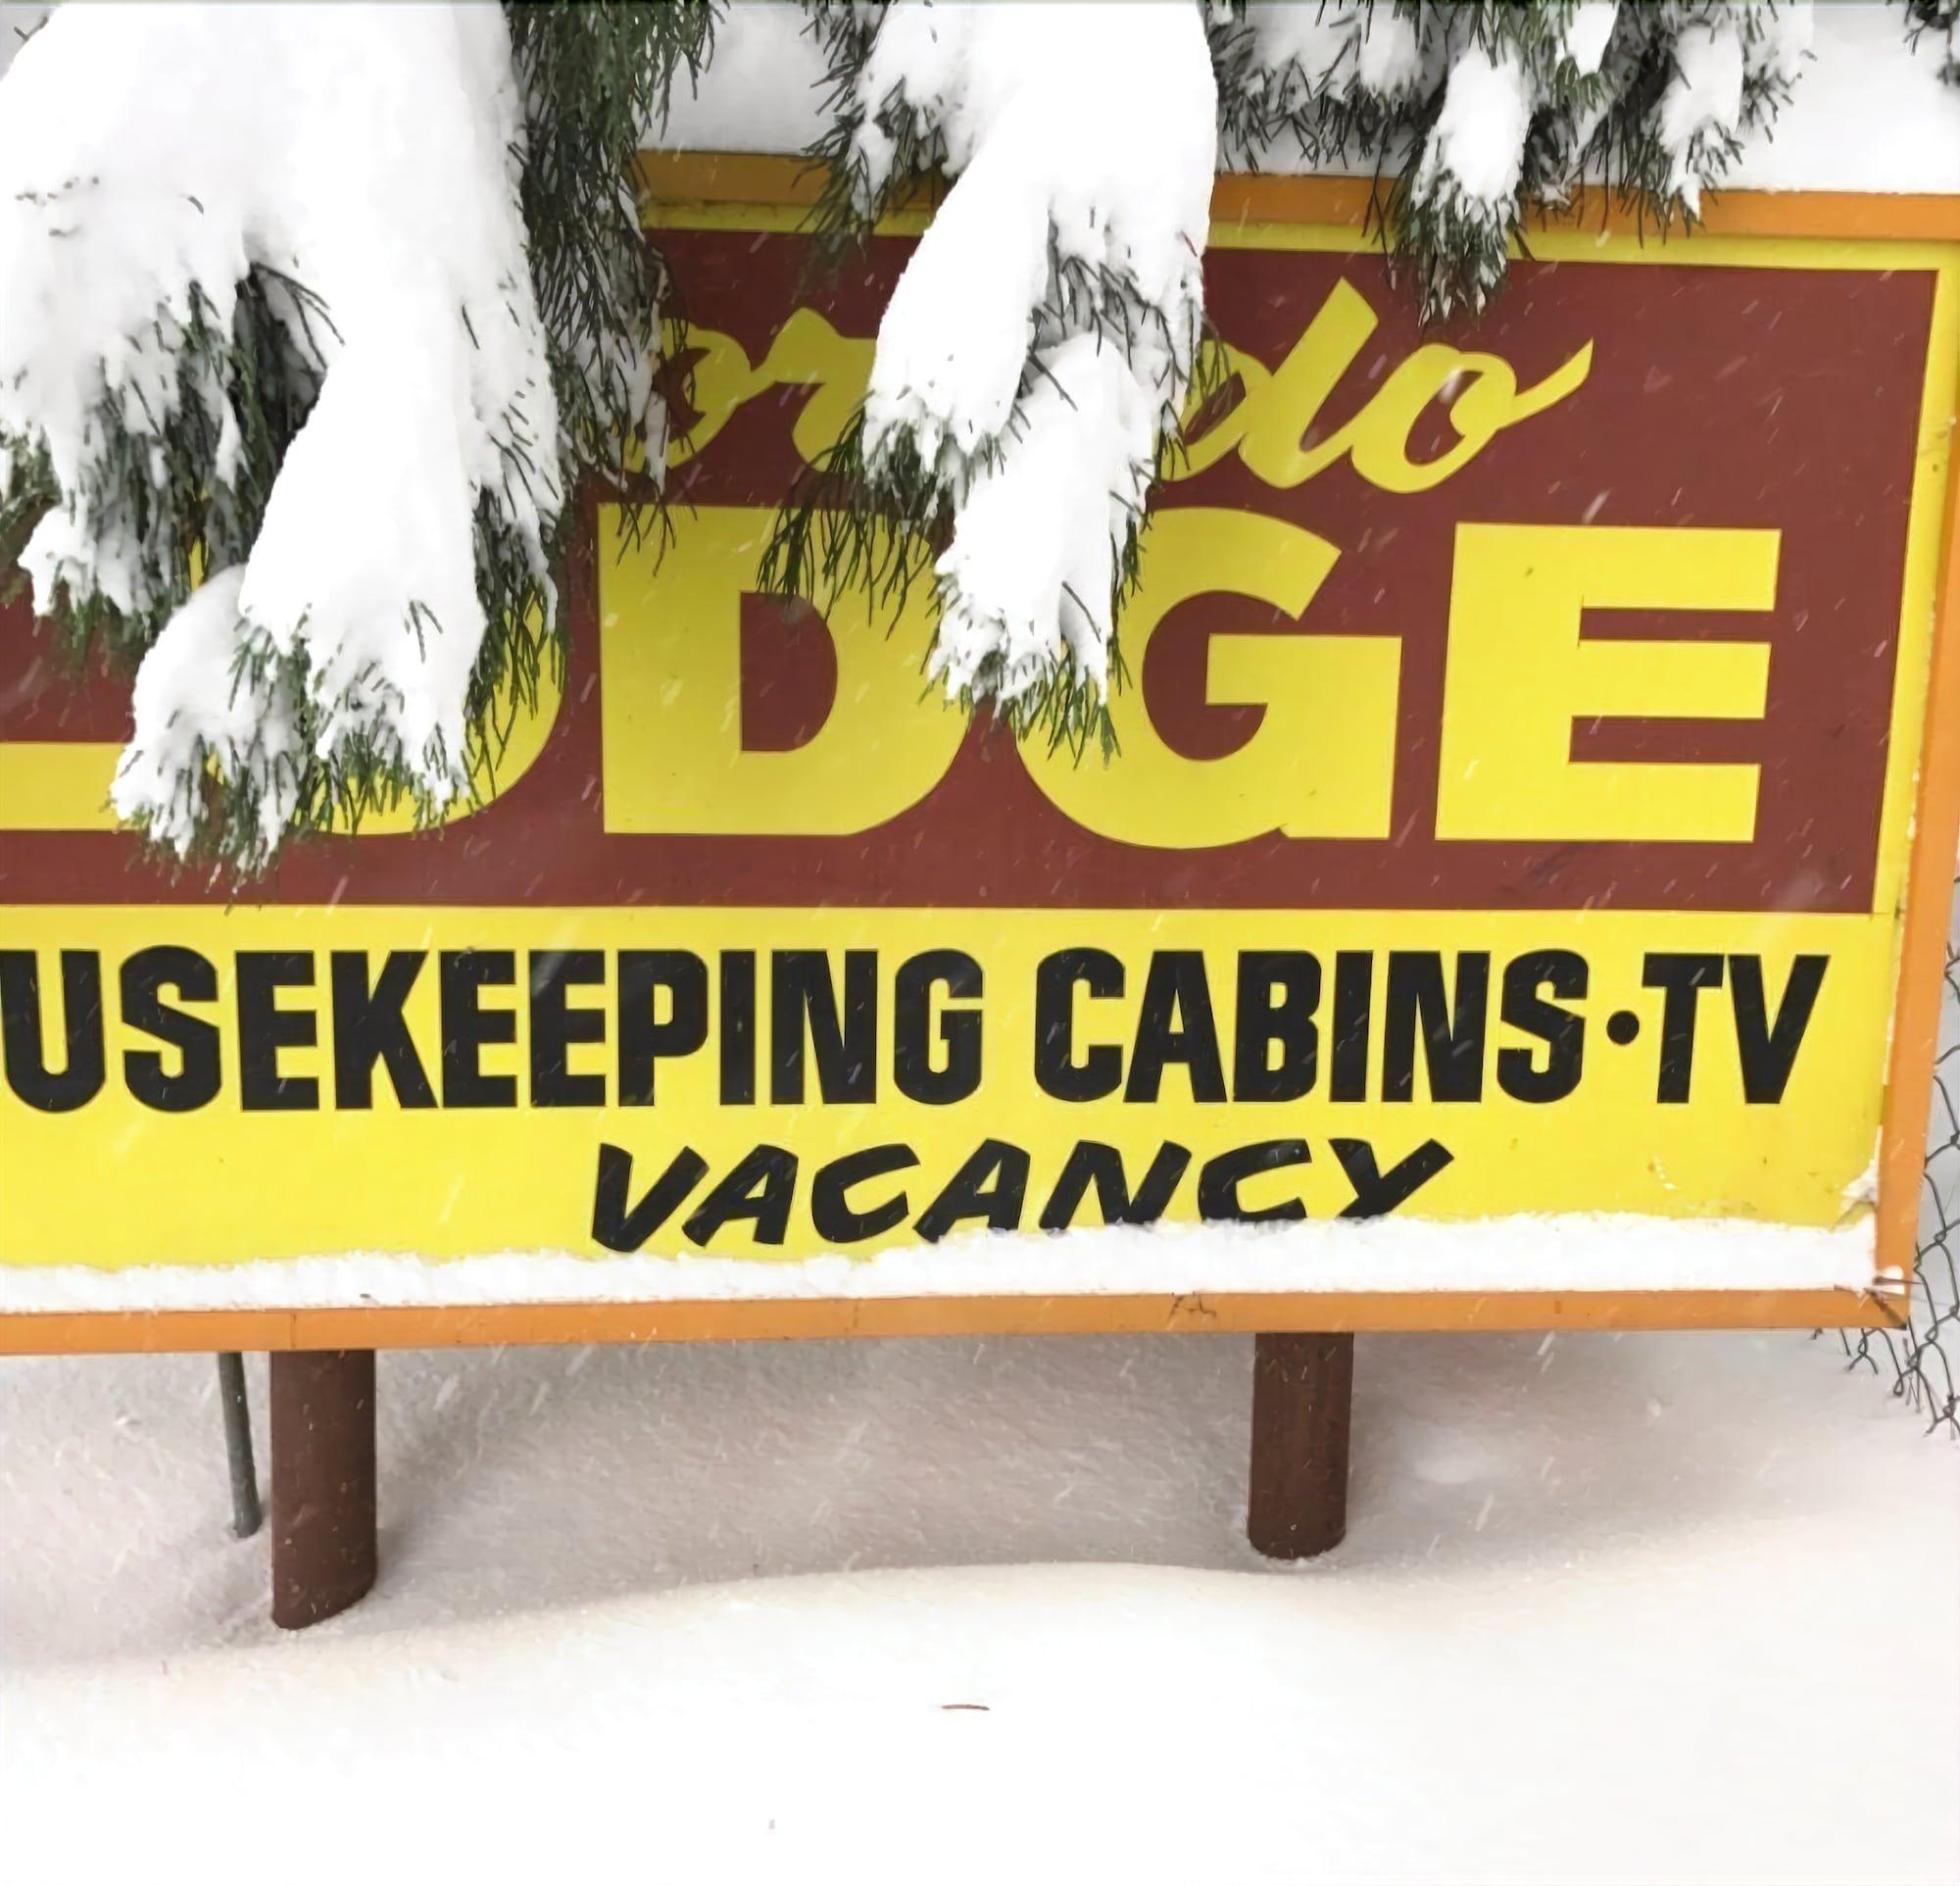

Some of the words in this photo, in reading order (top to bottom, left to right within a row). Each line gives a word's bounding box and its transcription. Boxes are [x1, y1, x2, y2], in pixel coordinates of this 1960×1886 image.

[0, 502, 1782, 849] DGE
[0, 946, 982, 1112] USEKEEPING
[593, 1139, 1451, 1252] VACANCY
